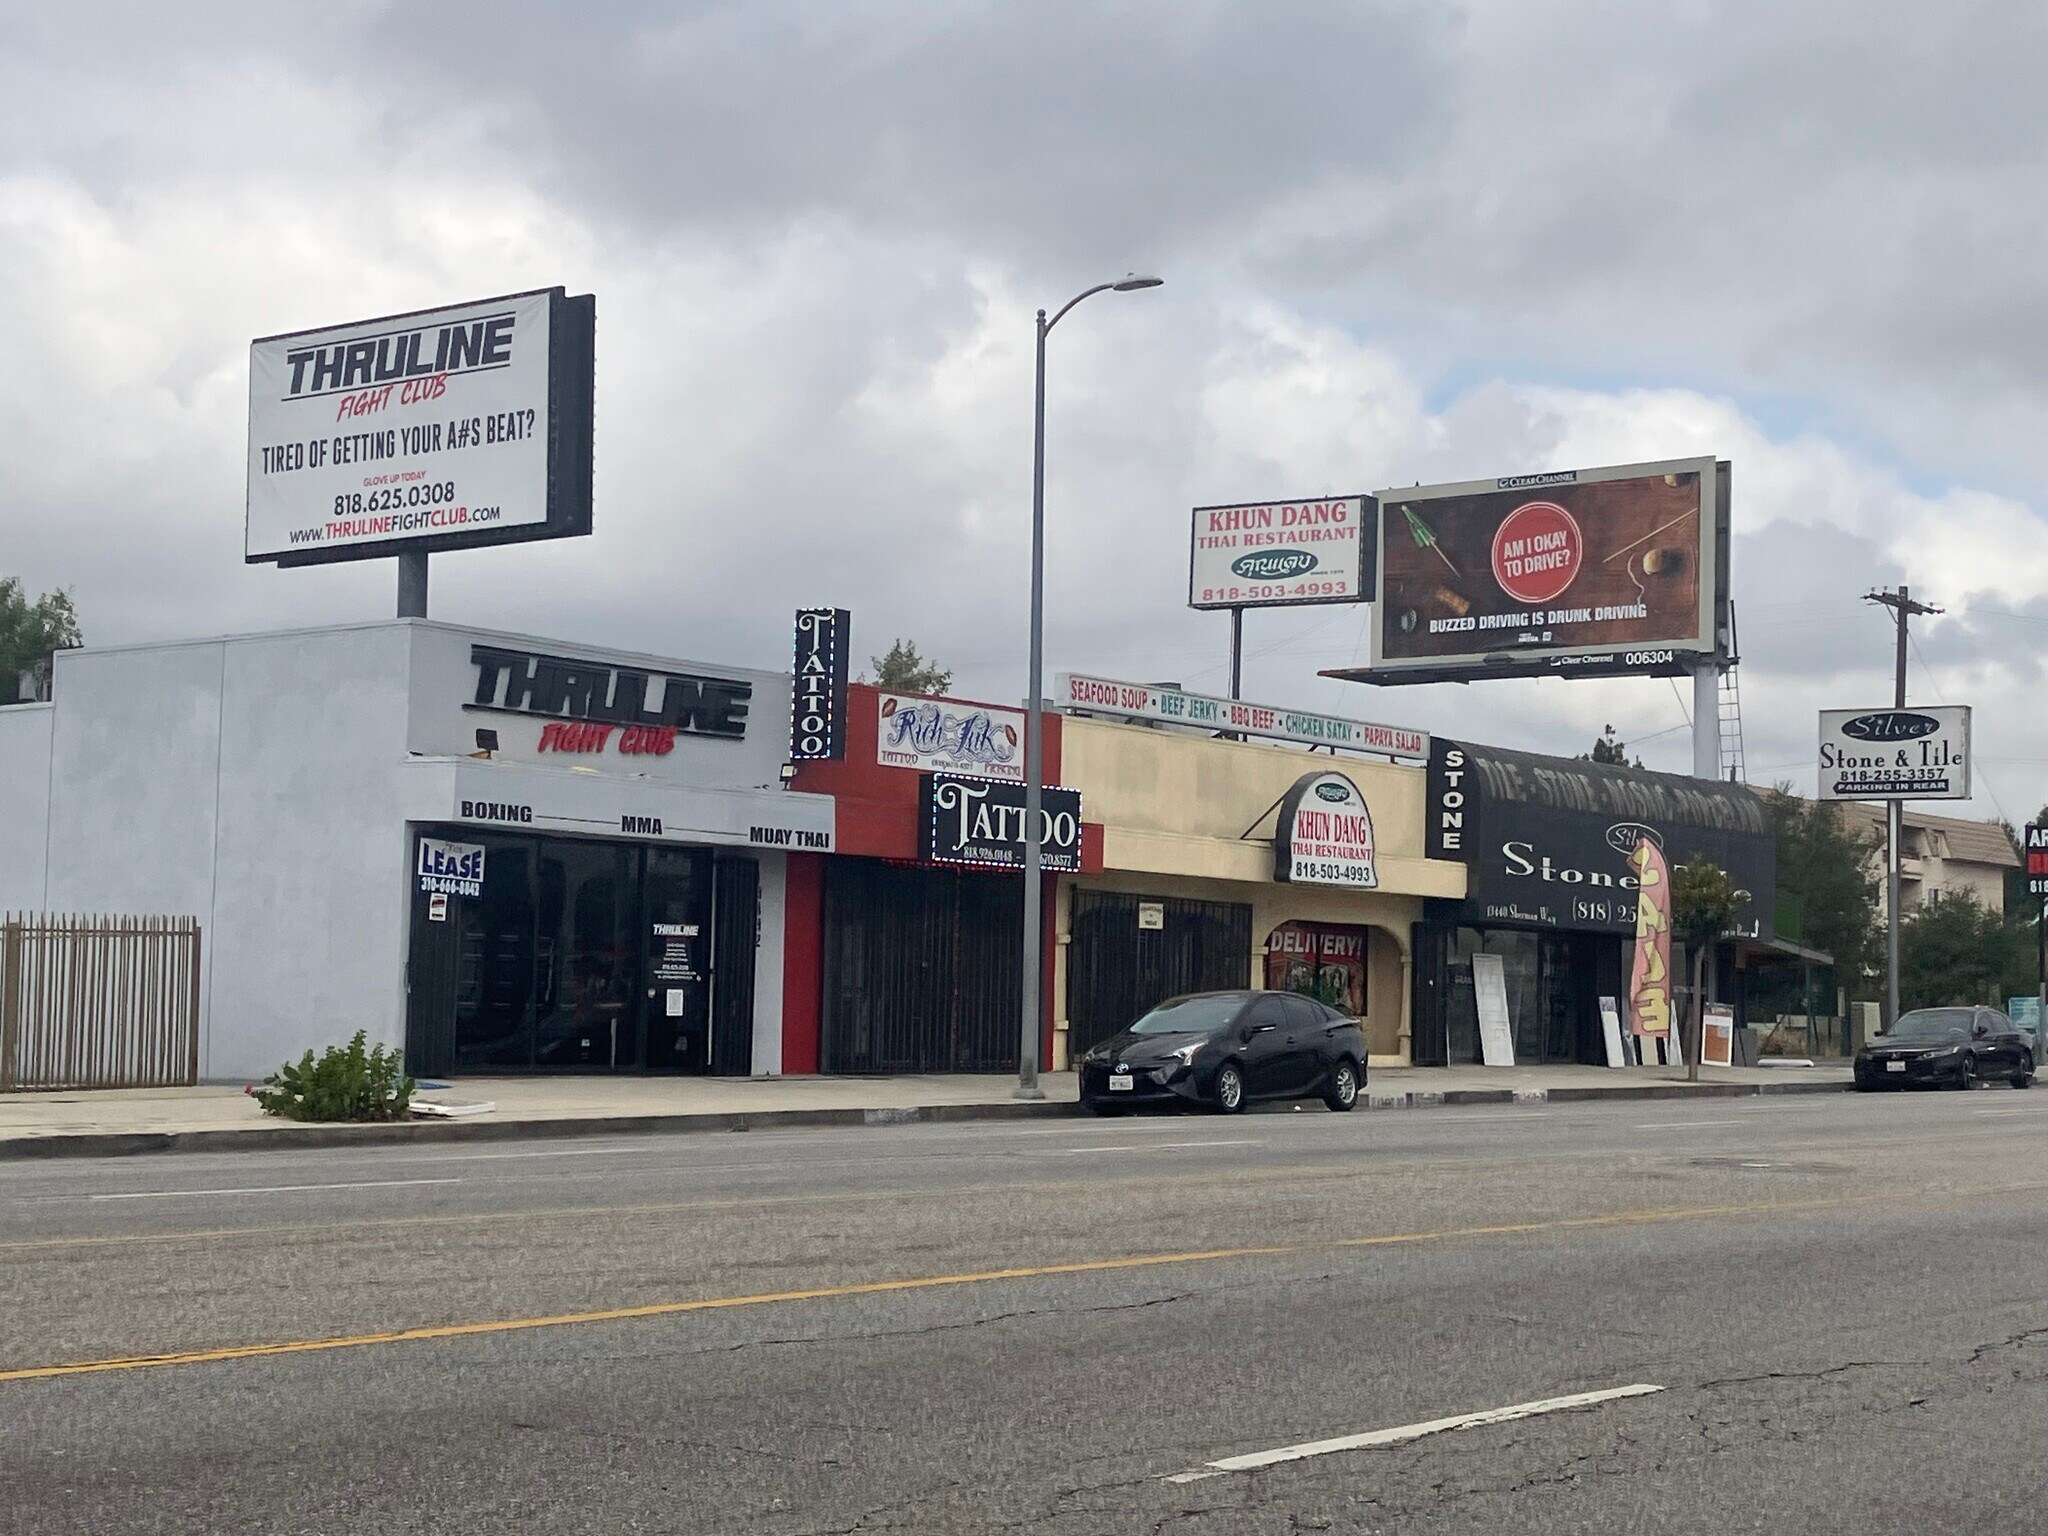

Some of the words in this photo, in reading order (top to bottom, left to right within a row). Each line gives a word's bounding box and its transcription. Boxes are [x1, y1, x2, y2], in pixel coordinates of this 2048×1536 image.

[287, 317, 515, 395] THRULINE
[337, 385, 393, 422] FIGHT
[400, 373, 448, 406] CLUB
[262, 442, 304, 474] TIRED
[309, 439, 328, 468] OF
[332, 430, 395, 465] GETTING
[401, 424, 442, 455] YOUR
[446, 418, 481, 450] A#S
[486, 409, 536, 444] BEAT?
[363, 474, 388, 487] GLOVE
[390, 473, 400, 484] UP
[401, 471, 427, 482] TODAY
[334, 482, 455, 516] 818.625.0308
[1209, 507, 1272, 532] KHUN
[1281, 502, 1346, 526] DANG
[1198, 535, 1237, 549] THAI
[1244, 526, 1357, 546] RESTAURANT
[1504, 543, 1524, 559] AM
[1527, 541, 1532, 555] I
[1534, 531, 1567, 553] OKAY
[1504, 560, 1522, 577] TO
[1525, 549, 1571, 573] DRIVE?
[1203, 581, 1347, 600] 818-503-4993
[1429, 617, 1475, 633] BUZZED
[1479, 612, 1529, 630] DRIVING
[1532, 611, 1545, 625] IS
[1548, 607, 1592, 624] DRUNK
[1595, 603, 1647, 621] DRIVING
[1625, 650, 1673, 665] 006304
[471, 657, 752, 734] THRULINE
[798, 612, 832, 754] TATTOO
[1071, 680, 1118, 706] SEAFOOD
[1121, 688, 1147, 710] SOUP
[1161, 694, 1185, 717] BEEF
[1188, 698, 1218, 722] JERKY
[1231, 705, 1250, 727] BBQ
[1252, 709, 1275, 730] BEEF
[538, 722, 614, 753] FIGHT
[618, 726, 678, 755] CLUB
[1285, 714, 1325, 739] CHICKEN
[1326, 720, 1352, 741] SATAY
[1364, 724, 1393, 748] PAPAYA
[1395, 731, 1421, 752] SALAD
[1850, 715, 1934, 737] Silver
[1820, 743, 1885, 769] Stone
[1895, 749, 1909, 766] &
[1919, 740, 1962, 766] Tile
[1837, 783, 1892, 791] PARKING
[1913, 781, 1946, 789] REAR
[1840, 768, 1945, 782] 818-255-3357
[461, 801, 533, 822] BOXING
[1442, 750, 1465, 850] STONE
[621, 815, 663, 835] MMA
[749, 827, 793, 846] MUAY
[795, 831, 830, 848] THAI
[1298, 810, 1330, 841] KHUN
[1334, 814, 1366, 845] DANG
[422, 843, 482, 879] LEASE
[1292, 842, 1313, 856] THAI
[1315, 844, 1371, 861] RESTAURANT
[1503, 841, 1640, 890] Stone
[1295, 861, 1370, 882] 818-503-4993
[1572, 895, 1612, 924] (818)
[1271, 930, 1362, 957] DELIVERY!
